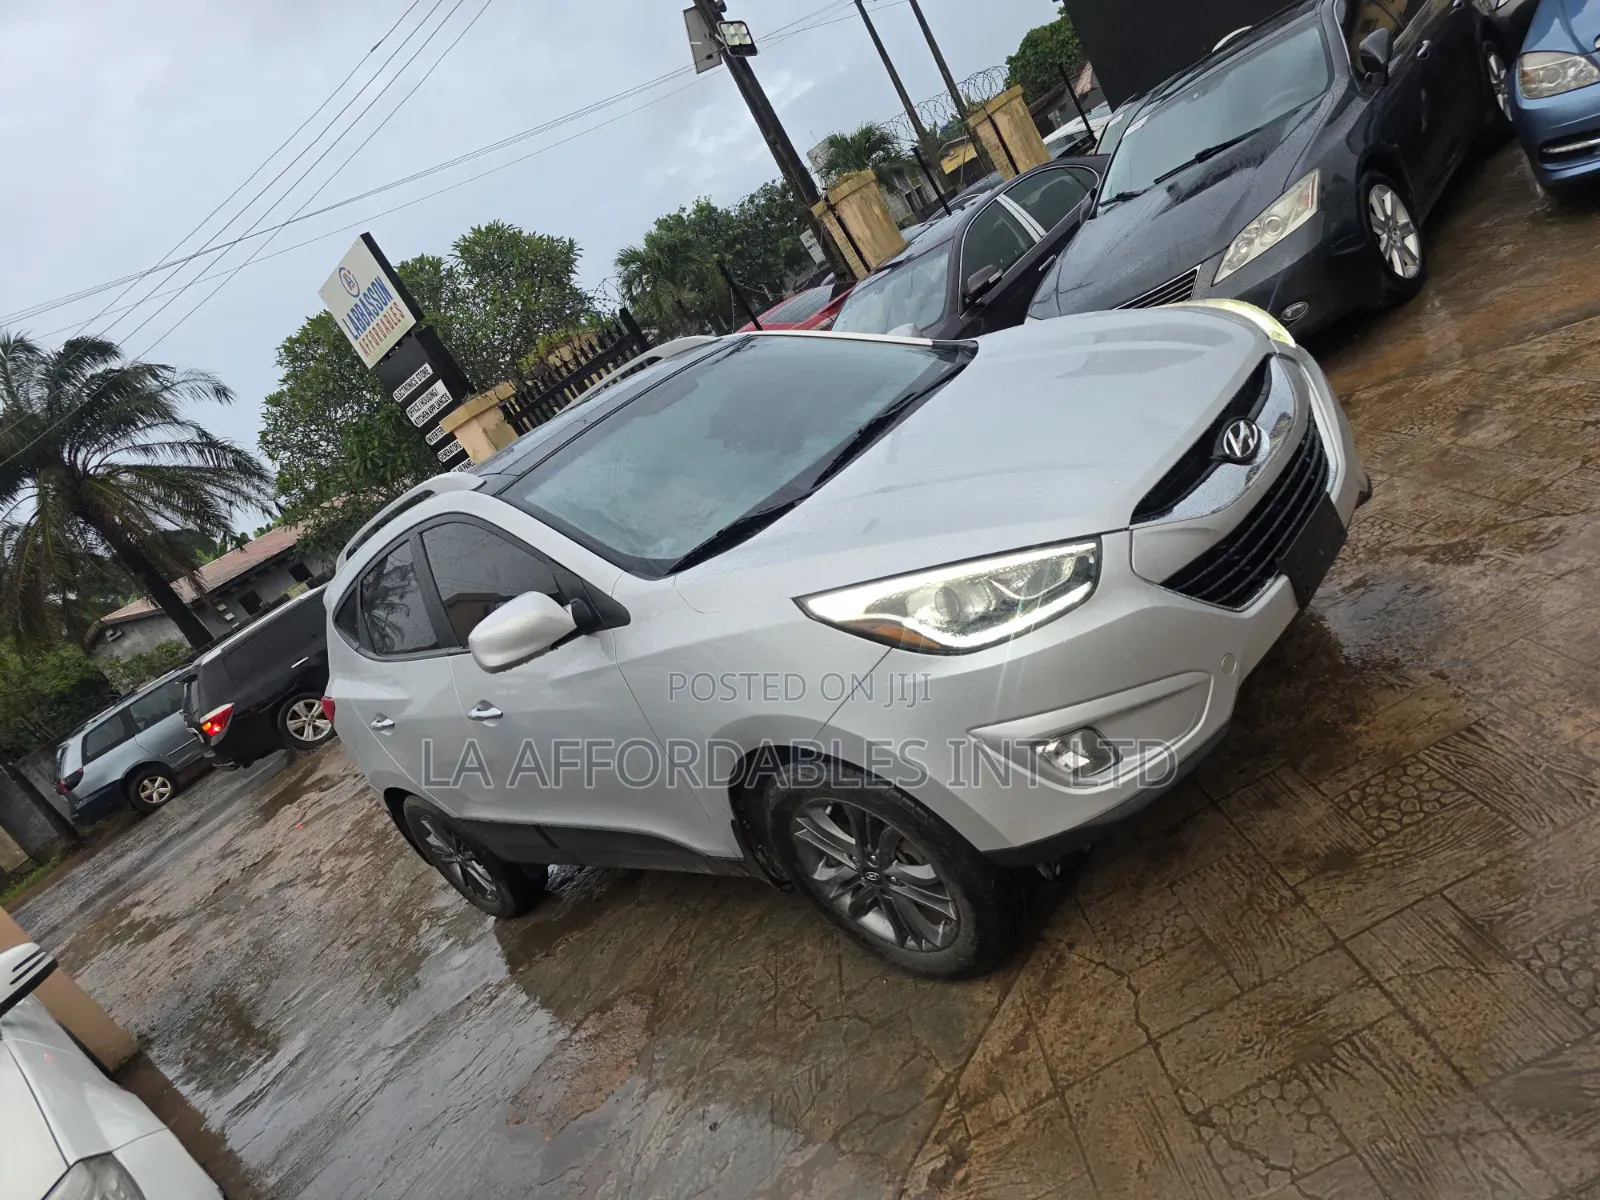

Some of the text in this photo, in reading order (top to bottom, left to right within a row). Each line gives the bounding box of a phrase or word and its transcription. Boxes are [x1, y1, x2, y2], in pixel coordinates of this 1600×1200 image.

[342, 275, 394, 341] LABBASSON
[358, 301, 405, 358] AFFORDABLES
[394, 366, 431, 401] ELECTRONICS STORE
[414, 392, 451, 426] KITCHEN APPLIANCES
